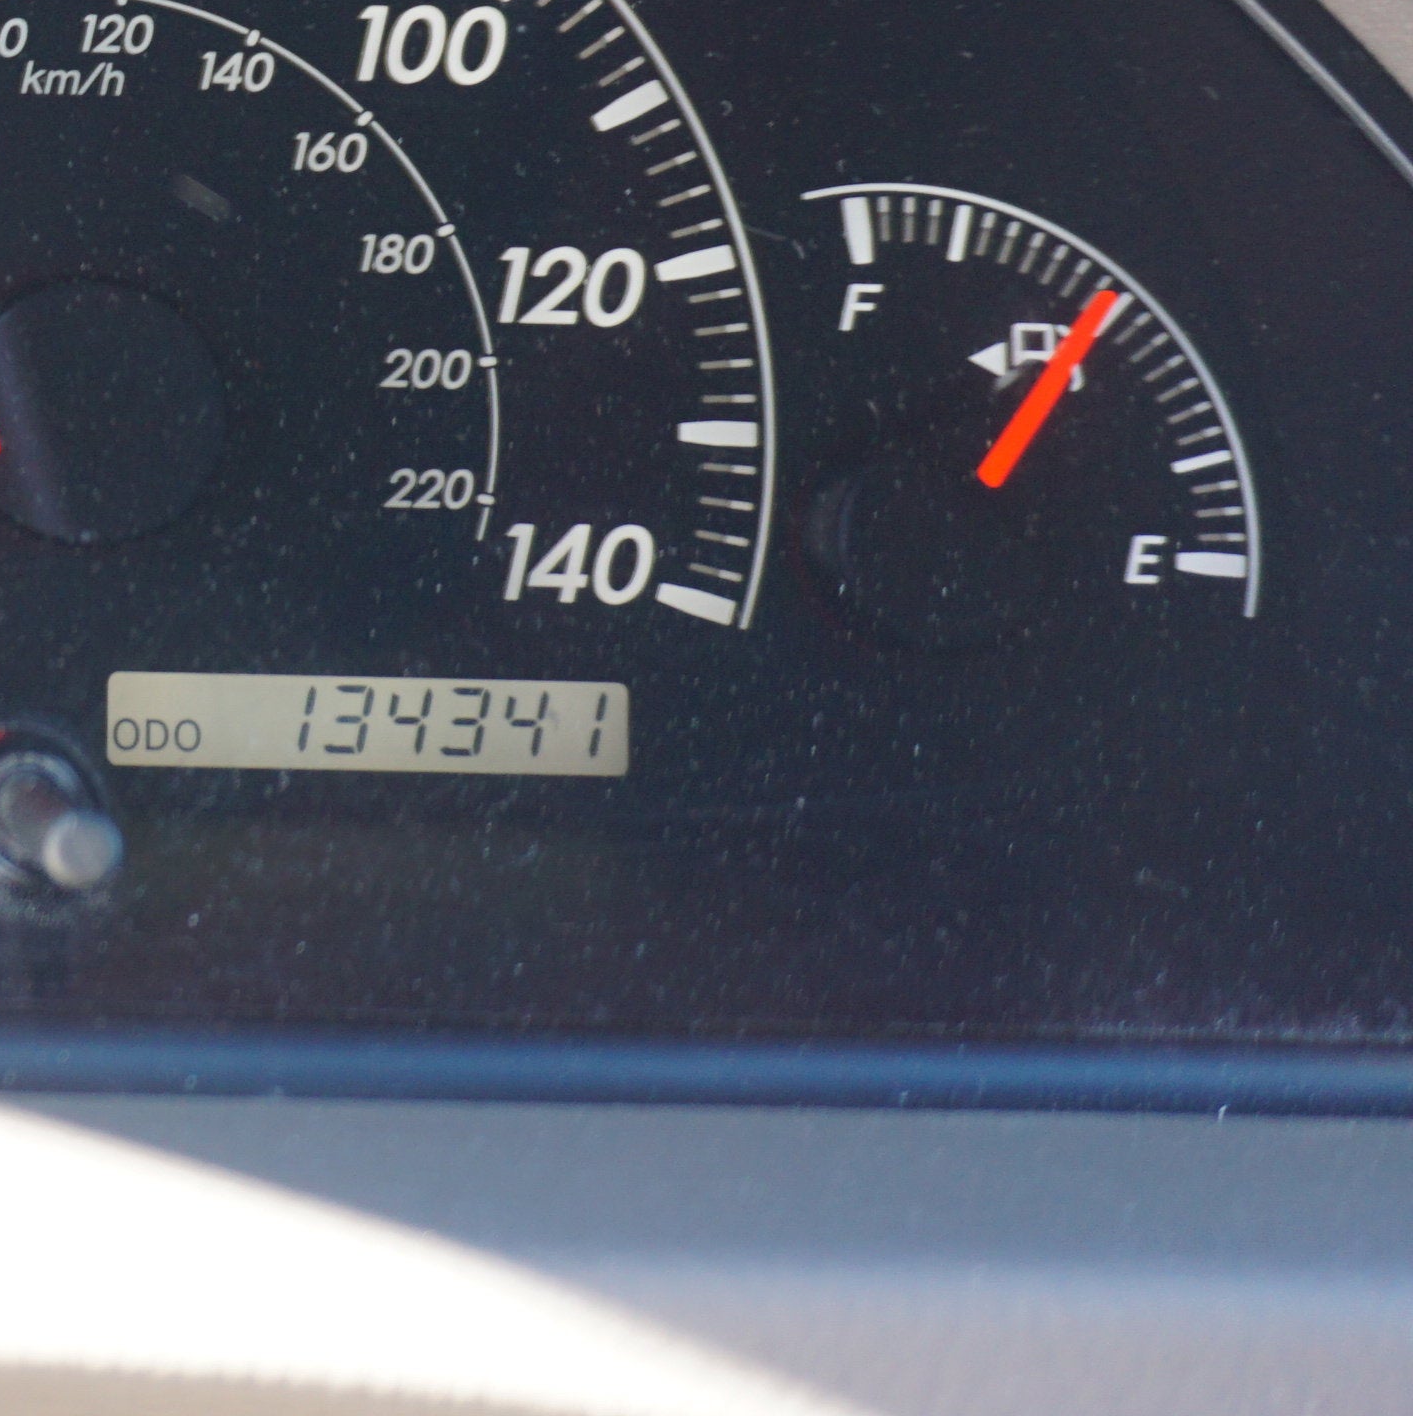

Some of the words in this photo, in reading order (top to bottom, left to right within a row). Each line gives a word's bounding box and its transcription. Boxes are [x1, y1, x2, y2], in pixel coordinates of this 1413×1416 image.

[81, 13, 155, 55] 120
[357, 4, 507, 86] 100
[20, 60, 125, 97] km/h
[200, 51, 275, 93] 140
[294, 131, 368, 173] 160
[360, 233, 435, 275] 180
[499, 245, 645, 328] 120
[839, 283, 884, 332] F
[379, 348, 472, 390] 200
[383, 468, 475, 510] 220
[504, 523, 654, 606] 140
[1124, 534, 1166, 585] E
[112, 717, 202, 753] ODO
[297, 684, 608, 760] 134341
